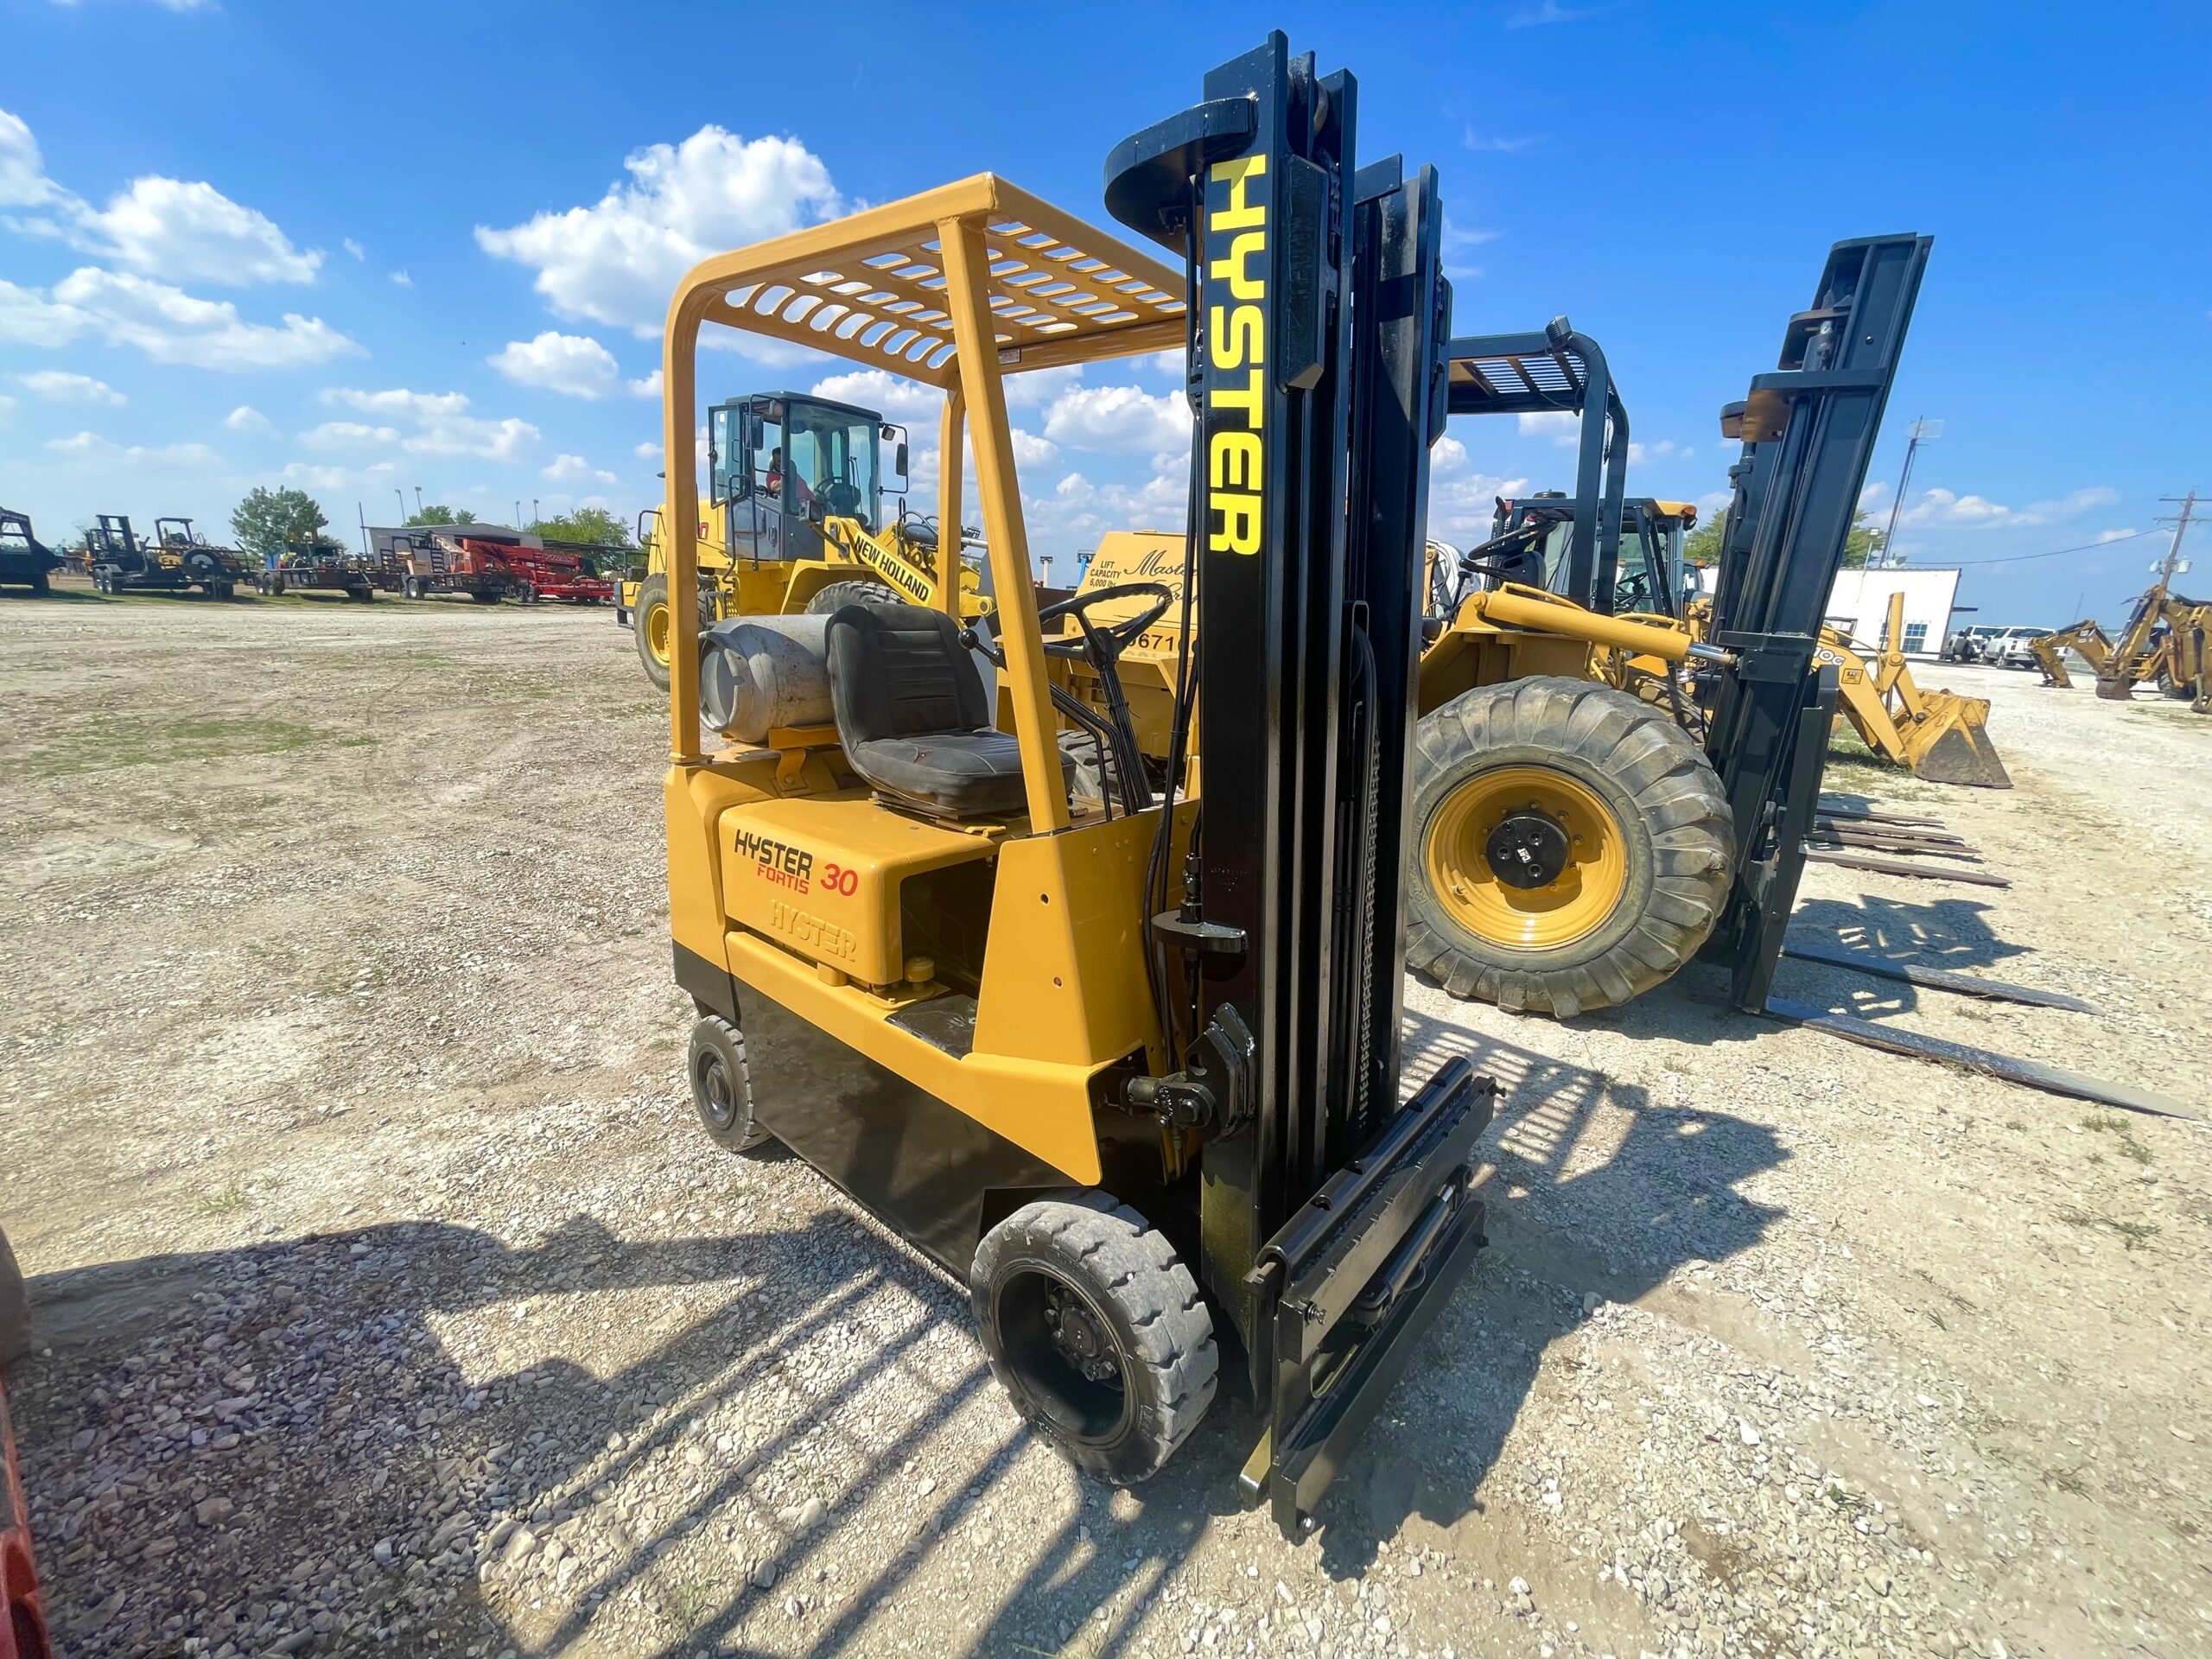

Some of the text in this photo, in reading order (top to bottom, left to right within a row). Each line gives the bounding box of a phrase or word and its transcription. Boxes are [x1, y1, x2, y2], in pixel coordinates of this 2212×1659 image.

[1210, 154, 1266, 556] HYSTER
[855, 536, 928, 601] NEW HOLLAND
[1090, 569, 1122, 579] CAPACITY
[1100, 560, 1115, 569] LIFT
[1123, 550, 1198, 576] Mast
[1090, 578, 1107, 588] 6,000
[734, 830, 859, 897] HYSTER 30
[757, 863, 810, 895] FORTIS
[771, 899, 857, 962] HYSTER
